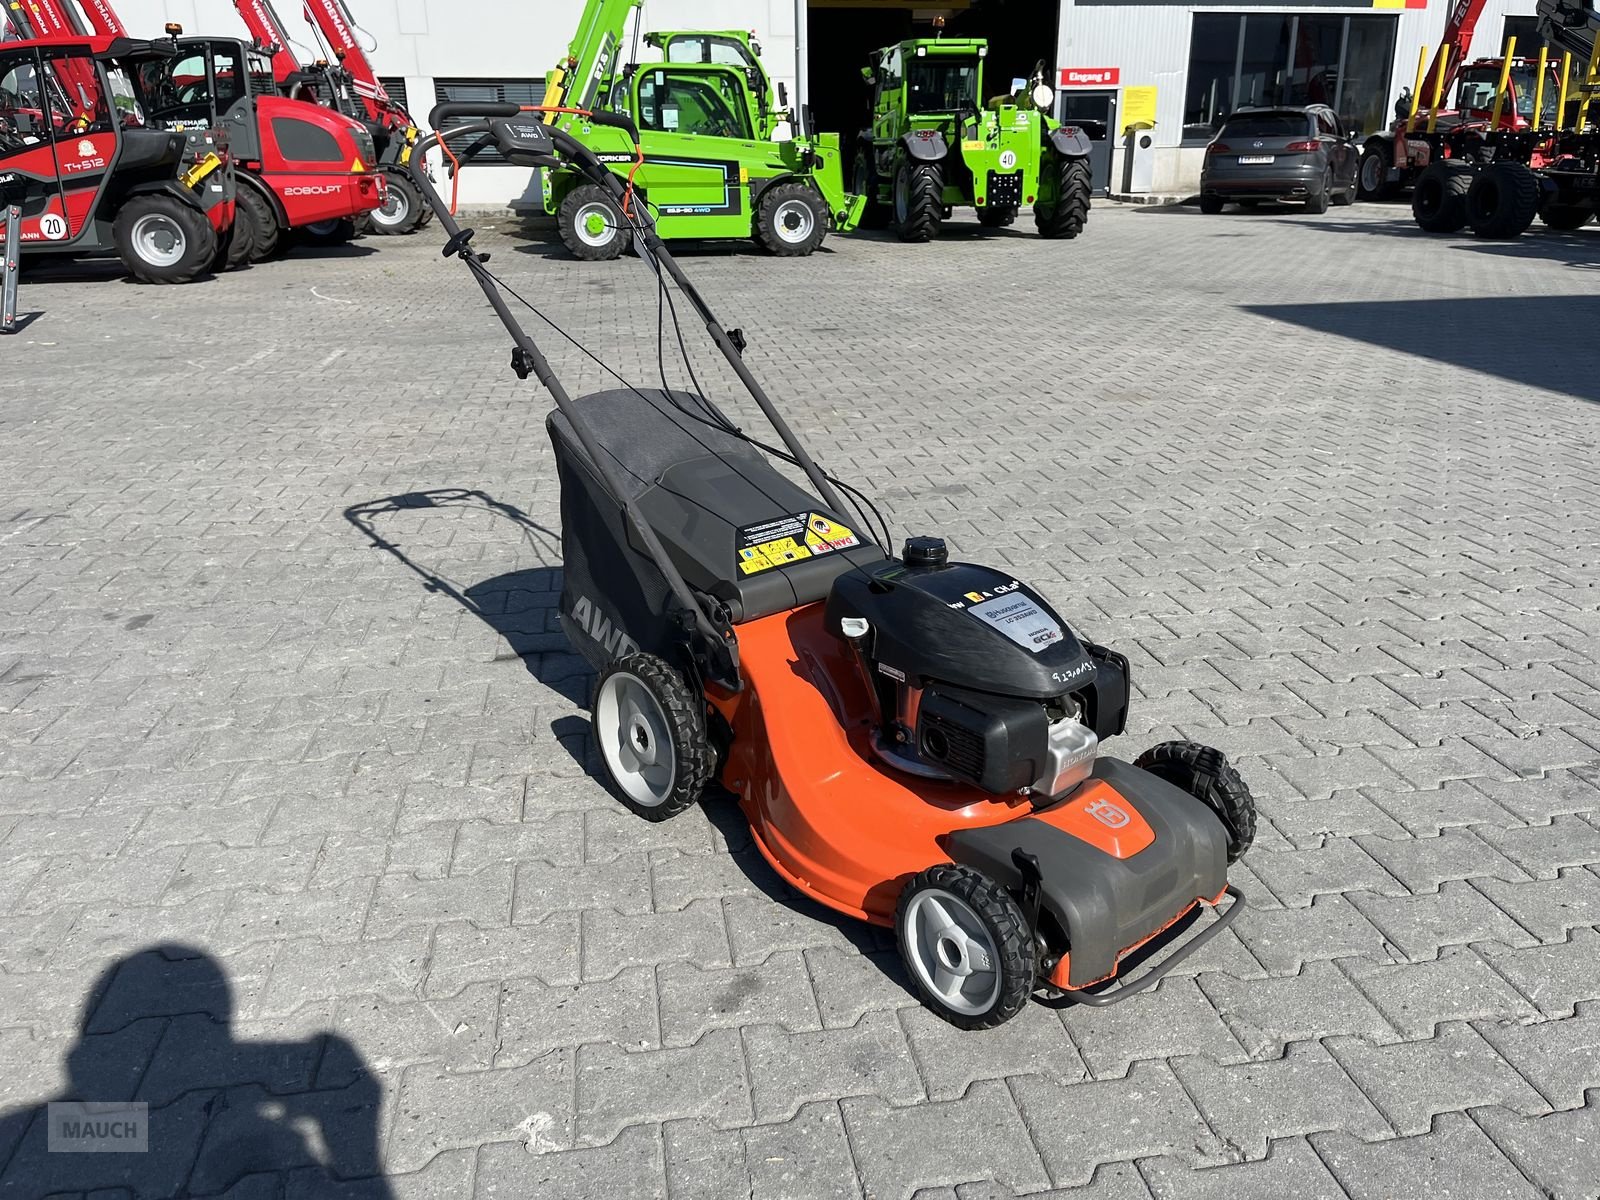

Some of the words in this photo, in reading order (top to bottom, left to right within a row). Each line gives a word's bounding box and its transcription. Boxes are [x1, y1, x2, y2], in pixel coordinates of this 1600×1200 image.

[1068, 72, 1103, 83] Eingang
[1104, 72, 1111, 81] B
[64, 158, 105, 172] T4512
[1002, 154, 1014, 166] 40
[284, 185, 342, 196] 2080LPT
[45, 219, 61, 235] 20
[815, 536, 853, 551] DANGER
[1028, 627, 1049, 637] HONDA
